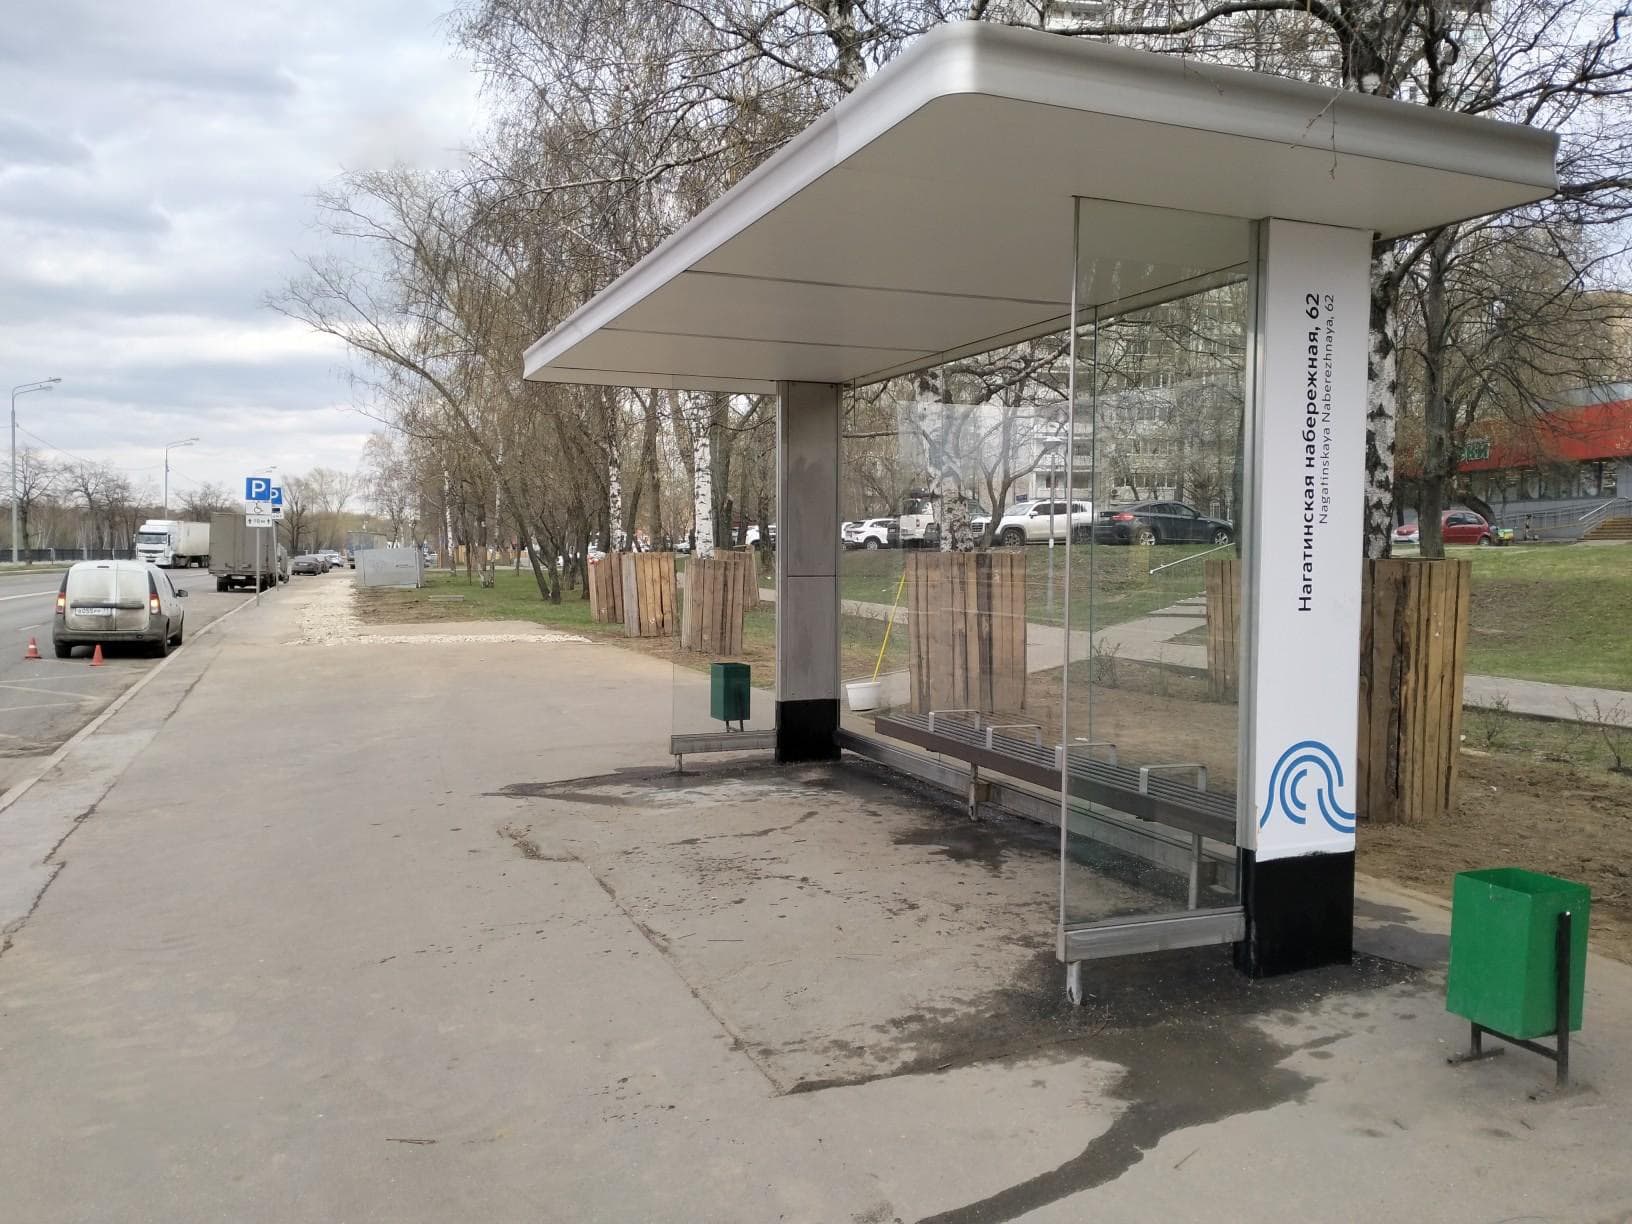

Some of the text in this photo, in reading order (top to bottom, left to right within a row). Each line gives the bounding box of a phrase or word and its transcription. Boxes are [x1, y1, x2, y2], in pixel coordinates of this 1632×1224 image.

[251, 480, 266, 498] P
[1298, 293, 1321, 612] Нагатинская набережная, 62
[1319, 294, 1335, 524] Nagatinskaya Naberezhnaya, 62
